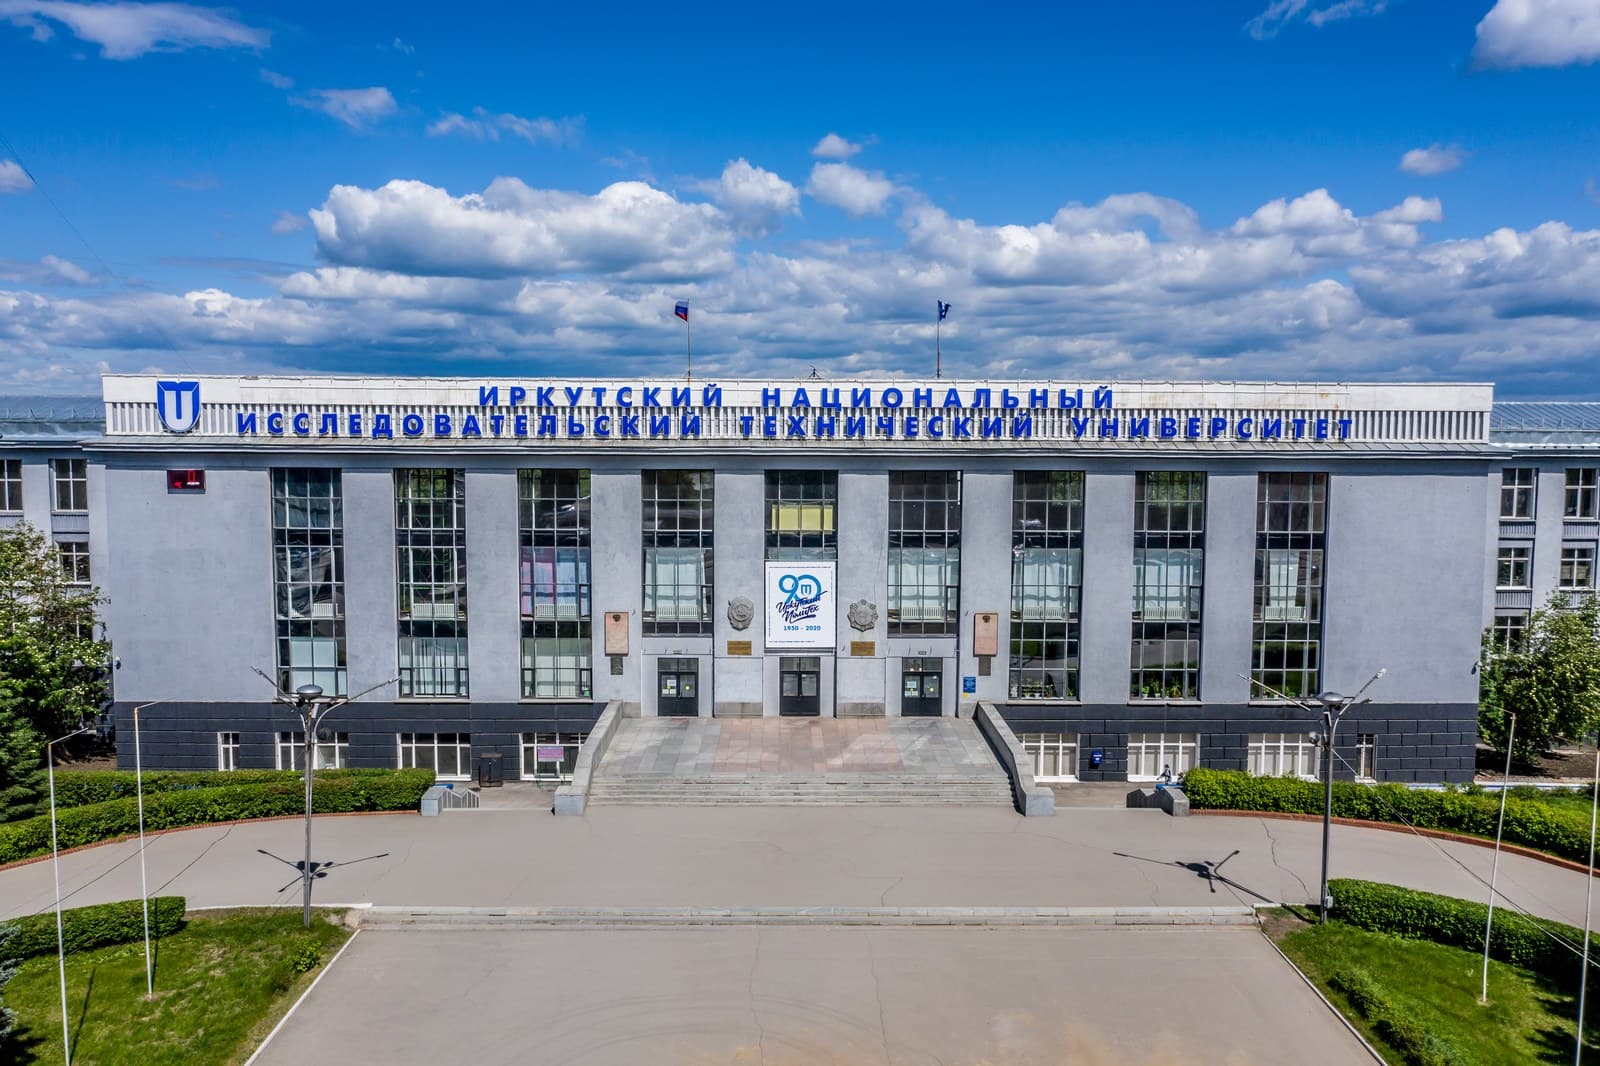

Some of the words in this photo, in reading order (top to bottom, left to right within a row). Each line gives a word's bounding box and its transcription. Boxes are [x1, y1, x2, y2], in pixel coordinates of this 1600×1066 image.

[479, 383, 722, 407] ИРКУТСКИЙ
[762, 386, 1112, 411] НАЦИОНАЛЬНЫЙ
[237, 411, 700, 439] ИССЛЕДОВАТЕЛЬСКИЙ
[740, 412, 1032, 437] ТЕХНИЧЕСКИЙ
[1072, 417, 1352, 439] УНИВЕРСИТЕТ
[778, 574, 822, 604] 90
